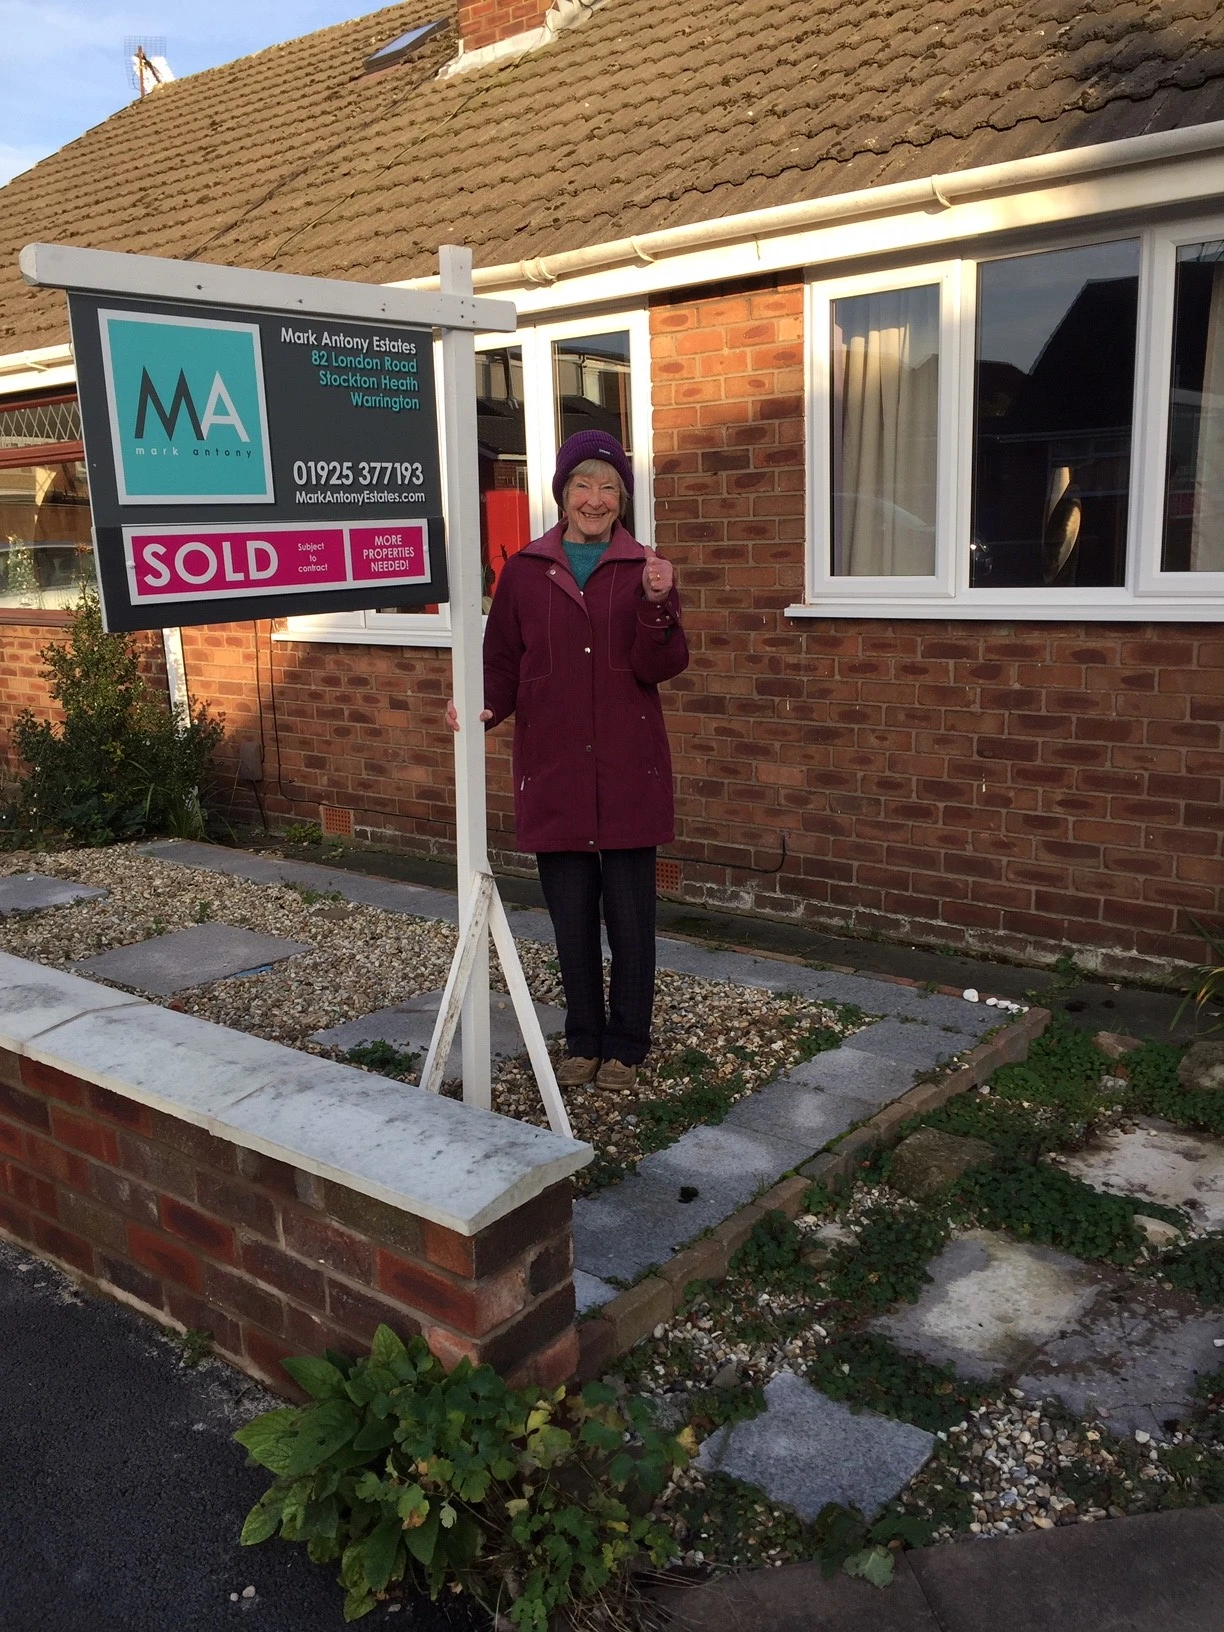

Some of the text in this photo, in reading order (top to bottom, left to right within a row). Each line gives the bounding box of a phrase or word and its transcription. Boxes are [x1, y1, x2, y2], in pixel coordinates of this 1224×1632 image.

[280, 327, 417, 354] Mark Antony Estates
[311, 350, 417, 373] 82 London Road
[319, 371, 418, 391] Stockton Heath
[134, 365, 250, 443] MA
[350, 391, 420, 412] Warrington
[135, 447, 252, 459] mark antony
[293, 460, 424, 486] 01925 377193
[295, 490, 426, 506] MarkAntonyEstates.com
[297, 542, 325, 553] Subject
[374, 534, 403, 547] MORE
[309, 554, 317, 563] to
[362, 546, 415, 560] PROPERTIES
[142, 540, 279, 587] SOLD
[297, 563, 328, 573] contract
[370, 559, 409, 573] NEEDED!
